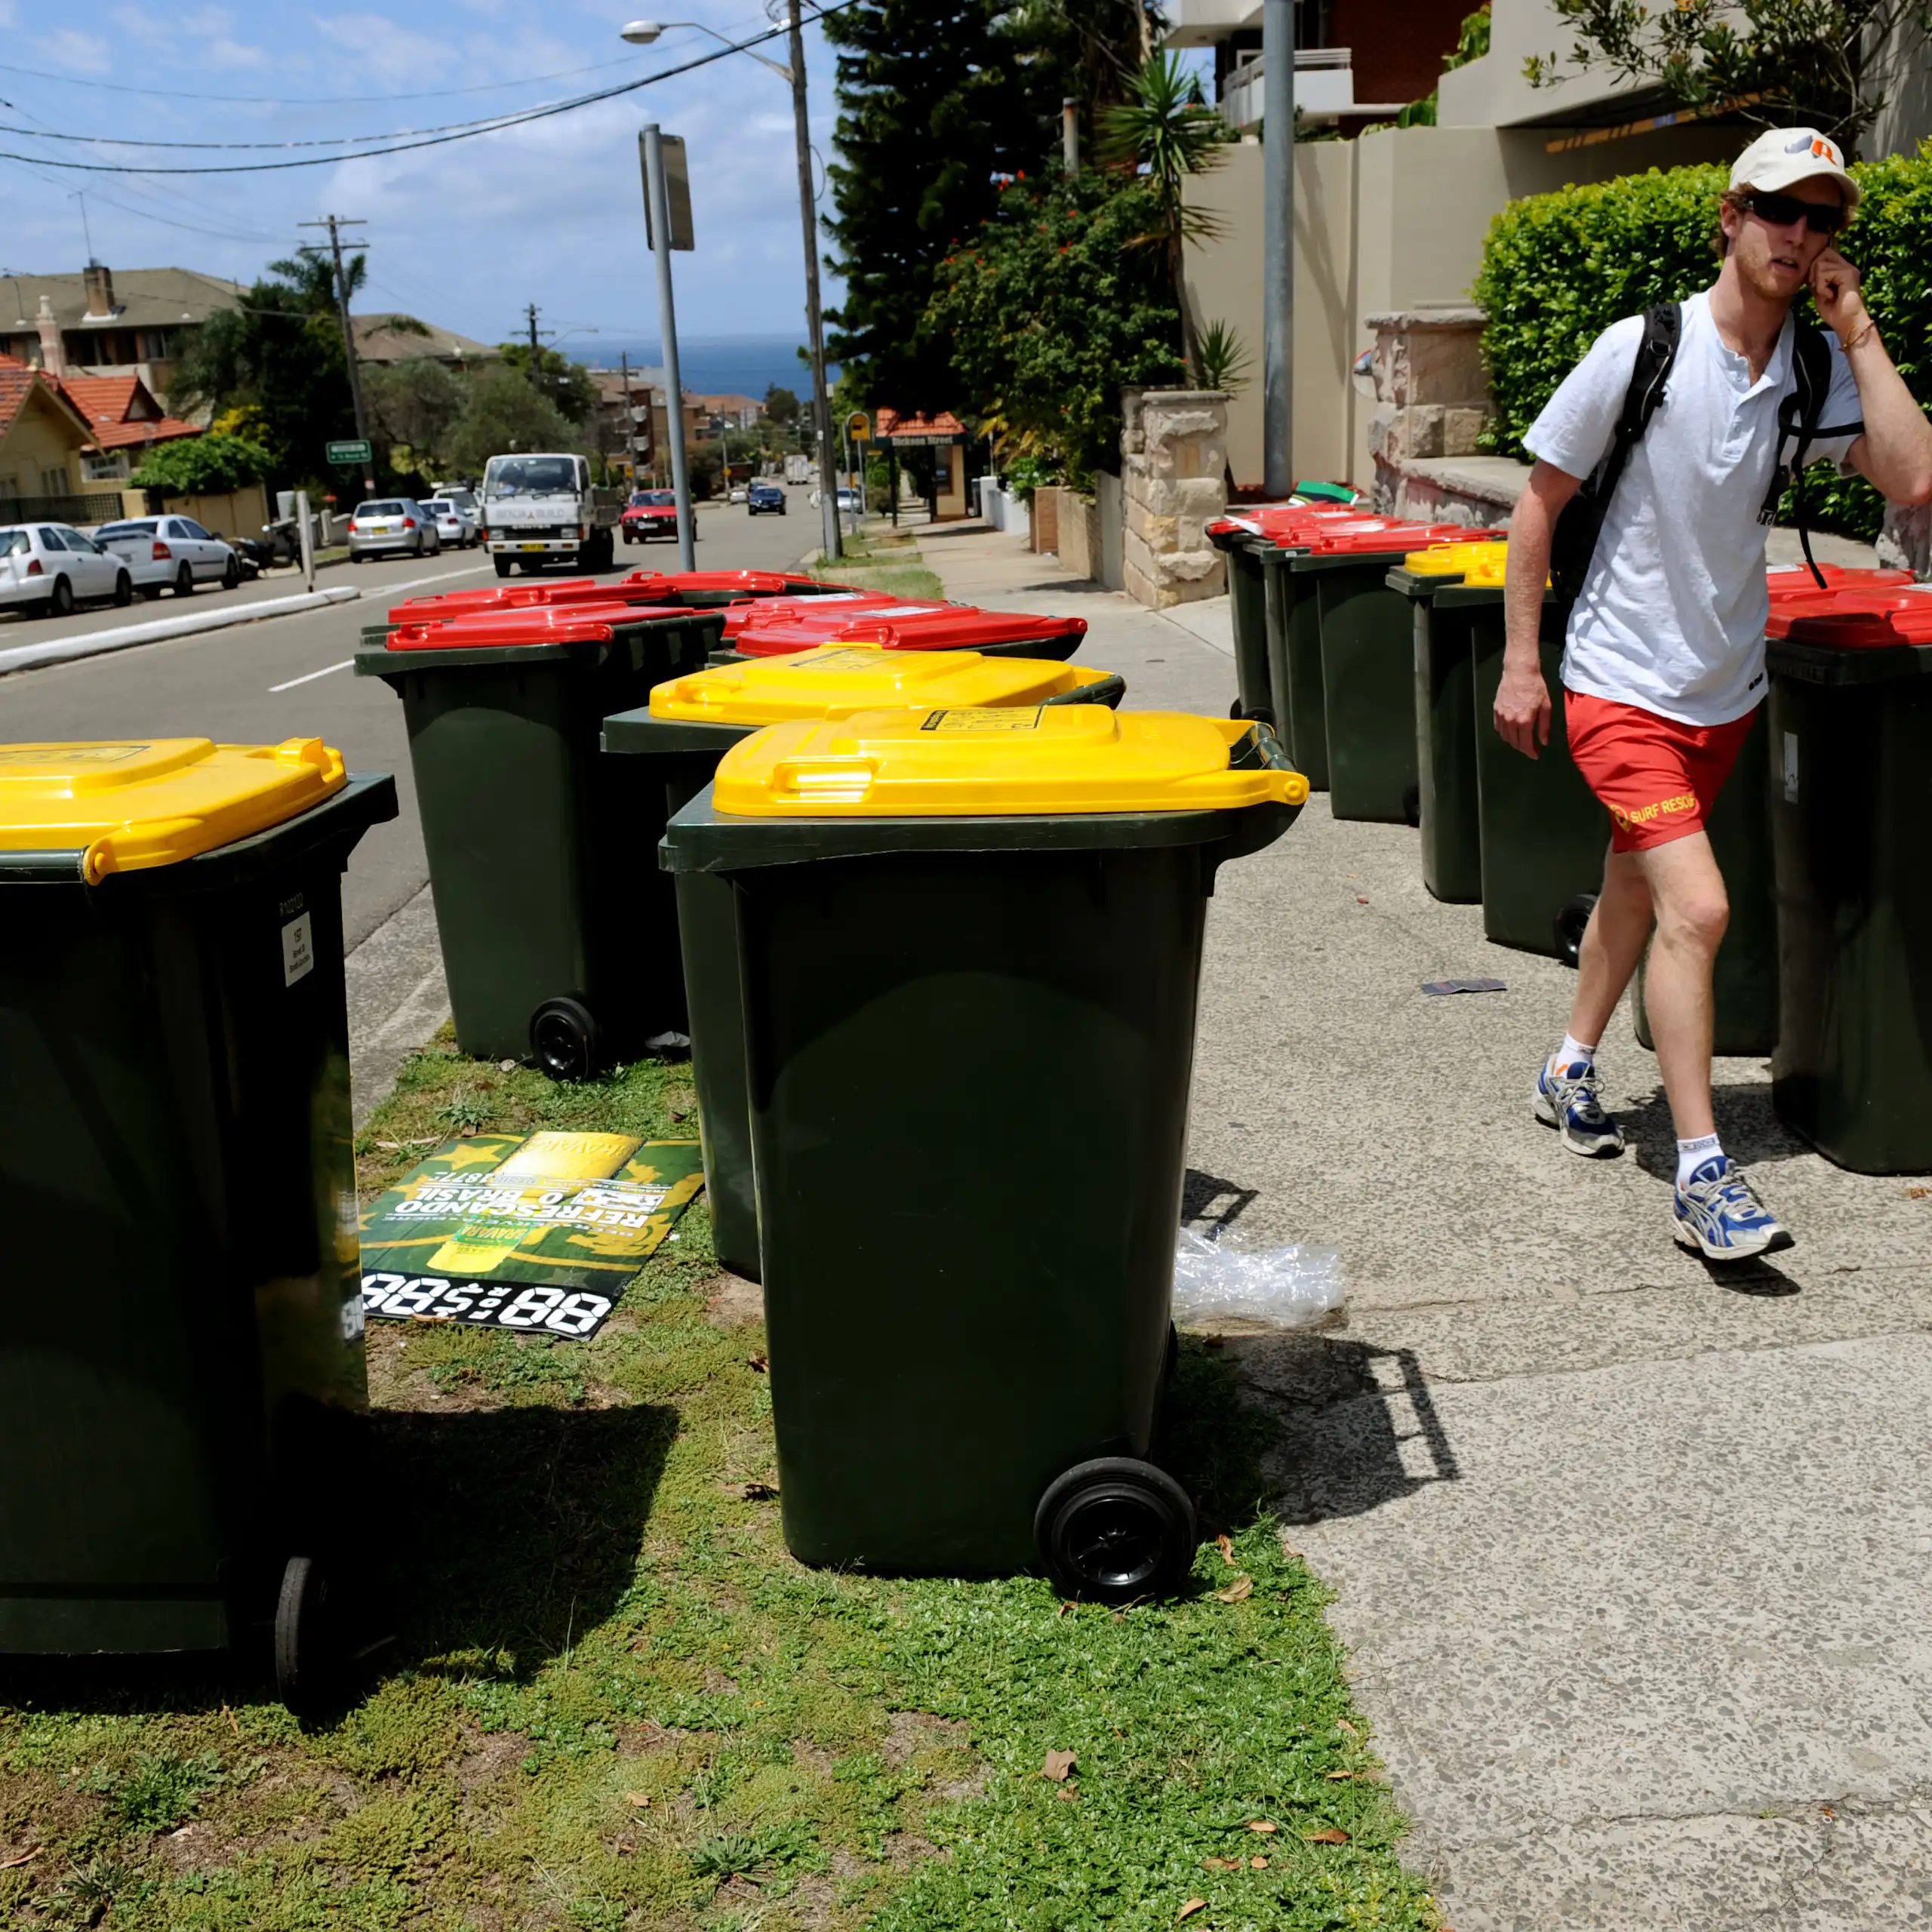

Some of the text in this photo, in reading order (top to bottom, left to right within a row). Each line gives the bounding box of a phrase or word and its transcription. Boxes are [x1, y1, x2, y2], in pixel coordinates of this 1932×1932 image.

[928, 435, 953, 445] Street
[1630, 803, 1659, 823] SURF
[416, 1185, 564, 1206] O BRASIL
[394, 1200, 650, 1229] REFRESCANDO
